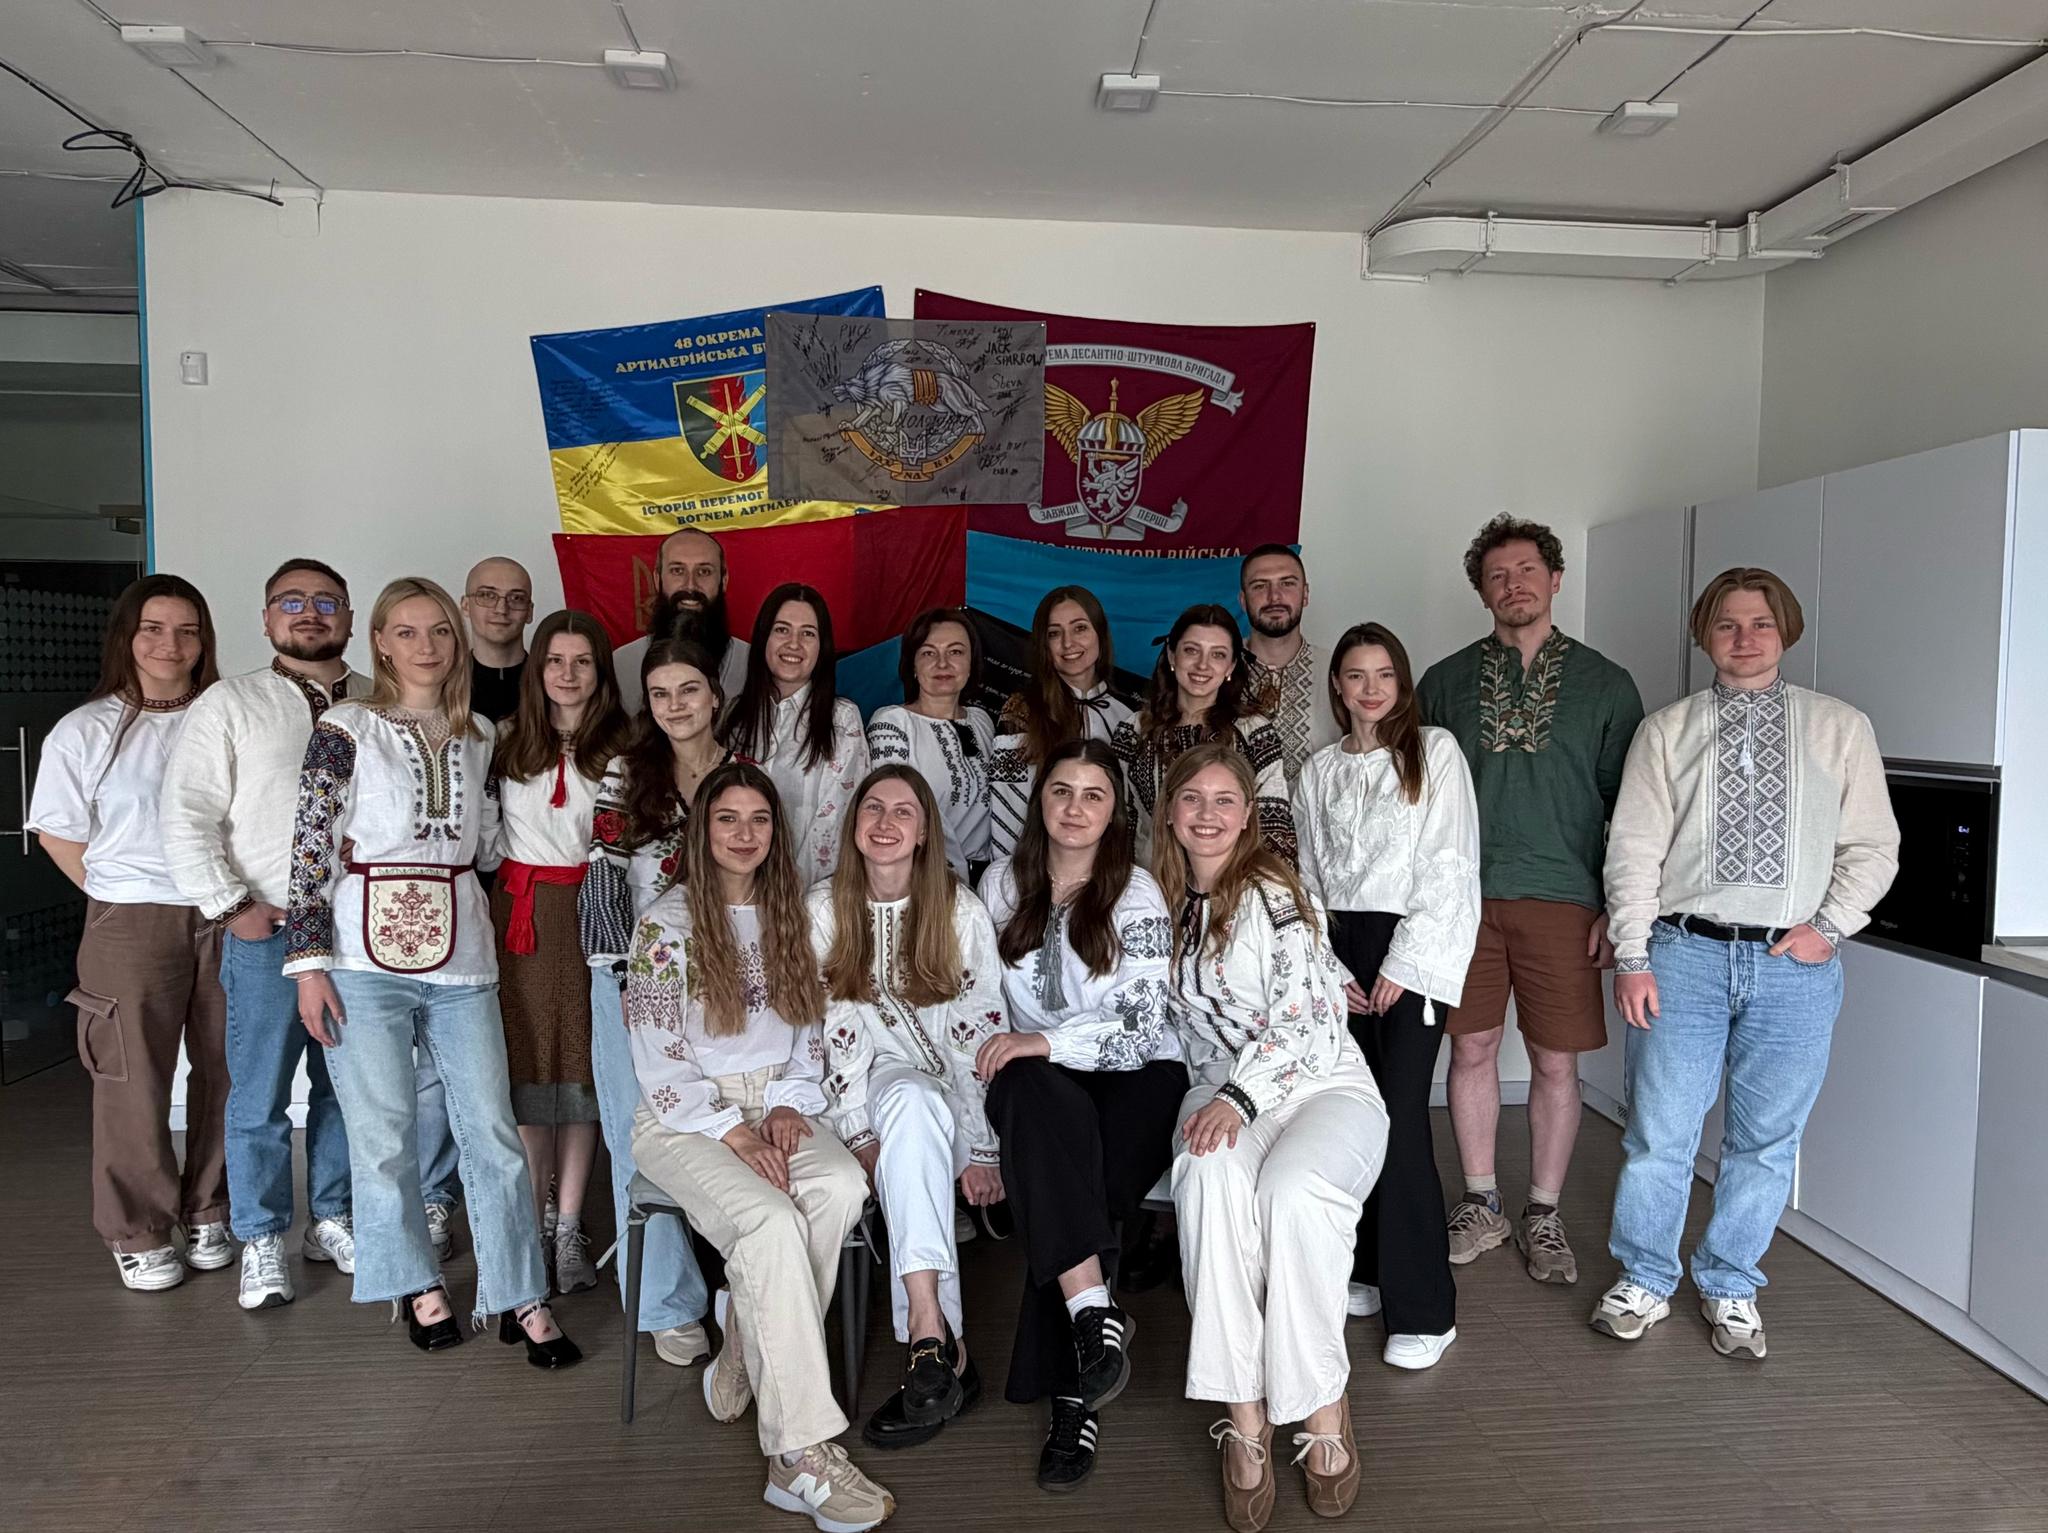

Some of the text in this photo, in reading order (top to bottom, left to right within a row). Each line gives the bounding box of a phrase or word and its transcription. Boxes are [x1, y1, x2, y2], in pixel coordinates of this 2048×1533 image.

[674, 327, 763, 349] 48 ОКРЕМА
[984, 342, 1011, 354] JACK
[615, 346, 749, 373] АРТИЛЕРІЙСЬКА
[995, 353, 1045, 367] SPARROW
[1046, 348, 1069, 360] ЕМА
[1185, 361, 1227, 386] БРИГАДА
[642, 491, 764, 515] ІСТОРІЯ ПЕРЕМОГ
[677, 510, 734, 525] ВОГНЕМ
[1041, 505, 1168, 528] ЗАВЖДИ ПЕРШІ
